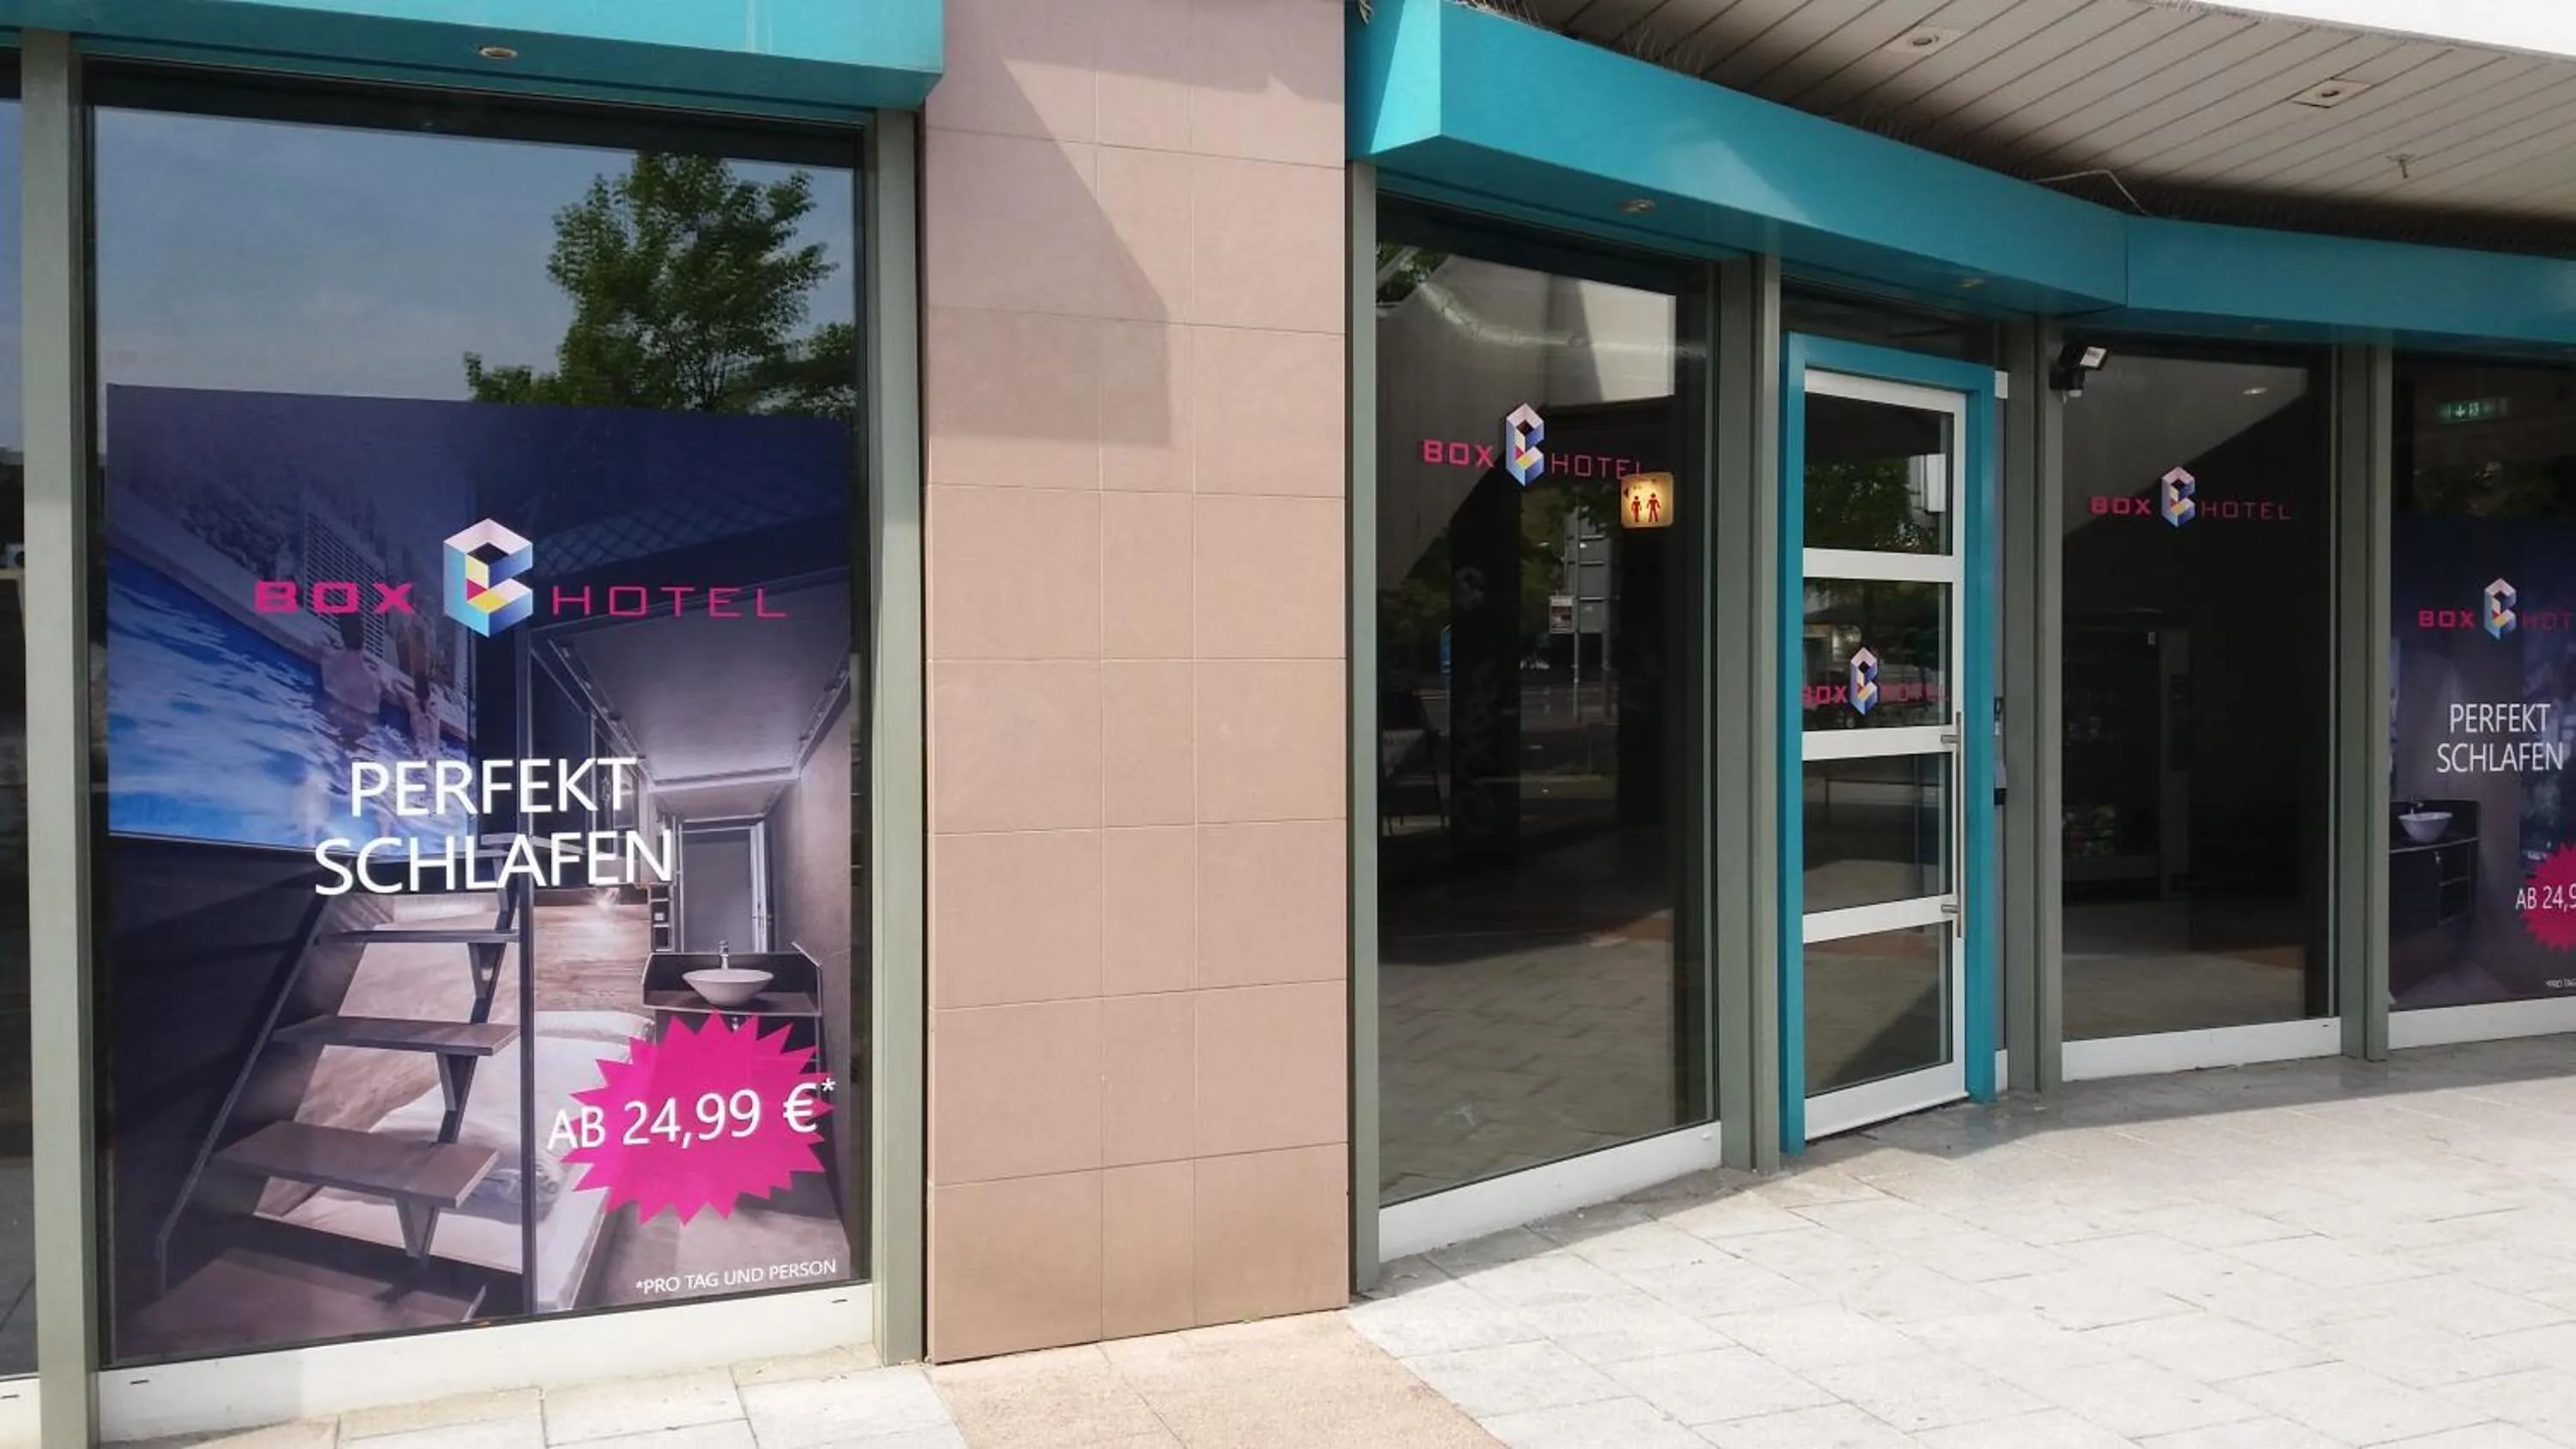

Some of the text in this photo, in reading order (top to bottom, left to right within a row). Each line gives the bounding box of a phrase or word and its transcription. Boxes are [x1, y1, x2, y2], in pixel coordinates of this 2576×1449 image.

[1424, 440, 1494, 468] BOX
[2090, 495, 2292, 520] BOX HOTEL
[254, 579, 787, 618] BOX HOTEL
[2418, 609, 2475, 629] BOX
[2450, 704, 2551, 733] PERFEKT
[2436, 741, 2564, 773] SCHLAFEN
[351, 757, 637, 817] PERFEKT
[315, 829, 672, 896] SCHLAFEN
[2515, 886, 2537, 910] AB
[548, 1106, 606, 1151] AB
[623, 1088, 761, 1150] 24,99
[685, 1271, 719, 1289] TAG
[724, 1267, 764, 1286] UND
[769, 1258, 836, 1281] PERSON
